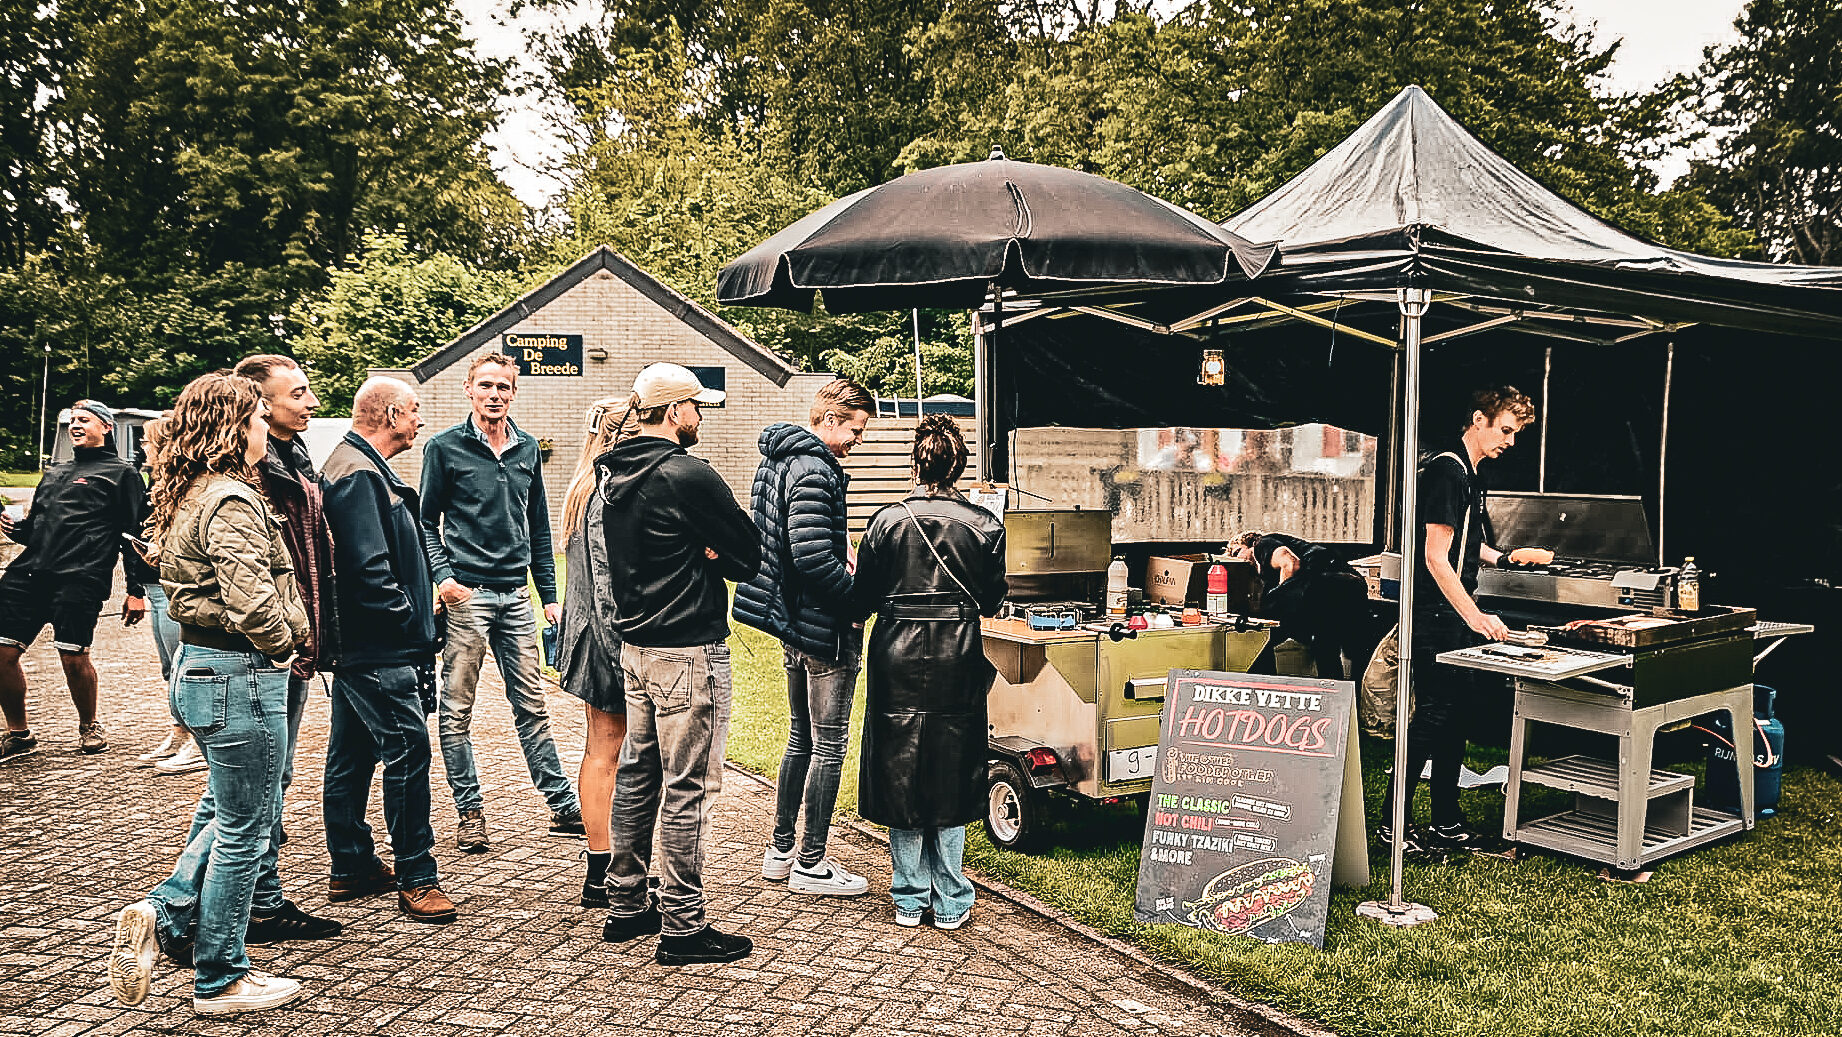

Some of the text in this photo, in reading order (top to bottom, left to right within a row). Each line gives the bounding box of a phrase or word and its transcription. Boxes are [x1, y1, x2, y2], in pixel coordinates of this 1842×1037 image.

[506, 334, 568, 350] Camping
[523, 348, 543, 361] De
[530, 361, 578, 375] Breede
[1192, 685, 1322, 711] DIKKE VETTE
[1178, 705, 1333, 750] HOTDOGS
[1158, 793, 1179, 809] THE
[1182, 796, 1230, 814] CLASSIC
[1155, 811, 1179, 827] HOT
[1181, 814, 1214, 832] CHILI
[1152, 829, 1189, 847] FUNKY
[1191, 834, 1234, 853] TZAZIKI
[1150, 847, 1193, 866] &MORE
